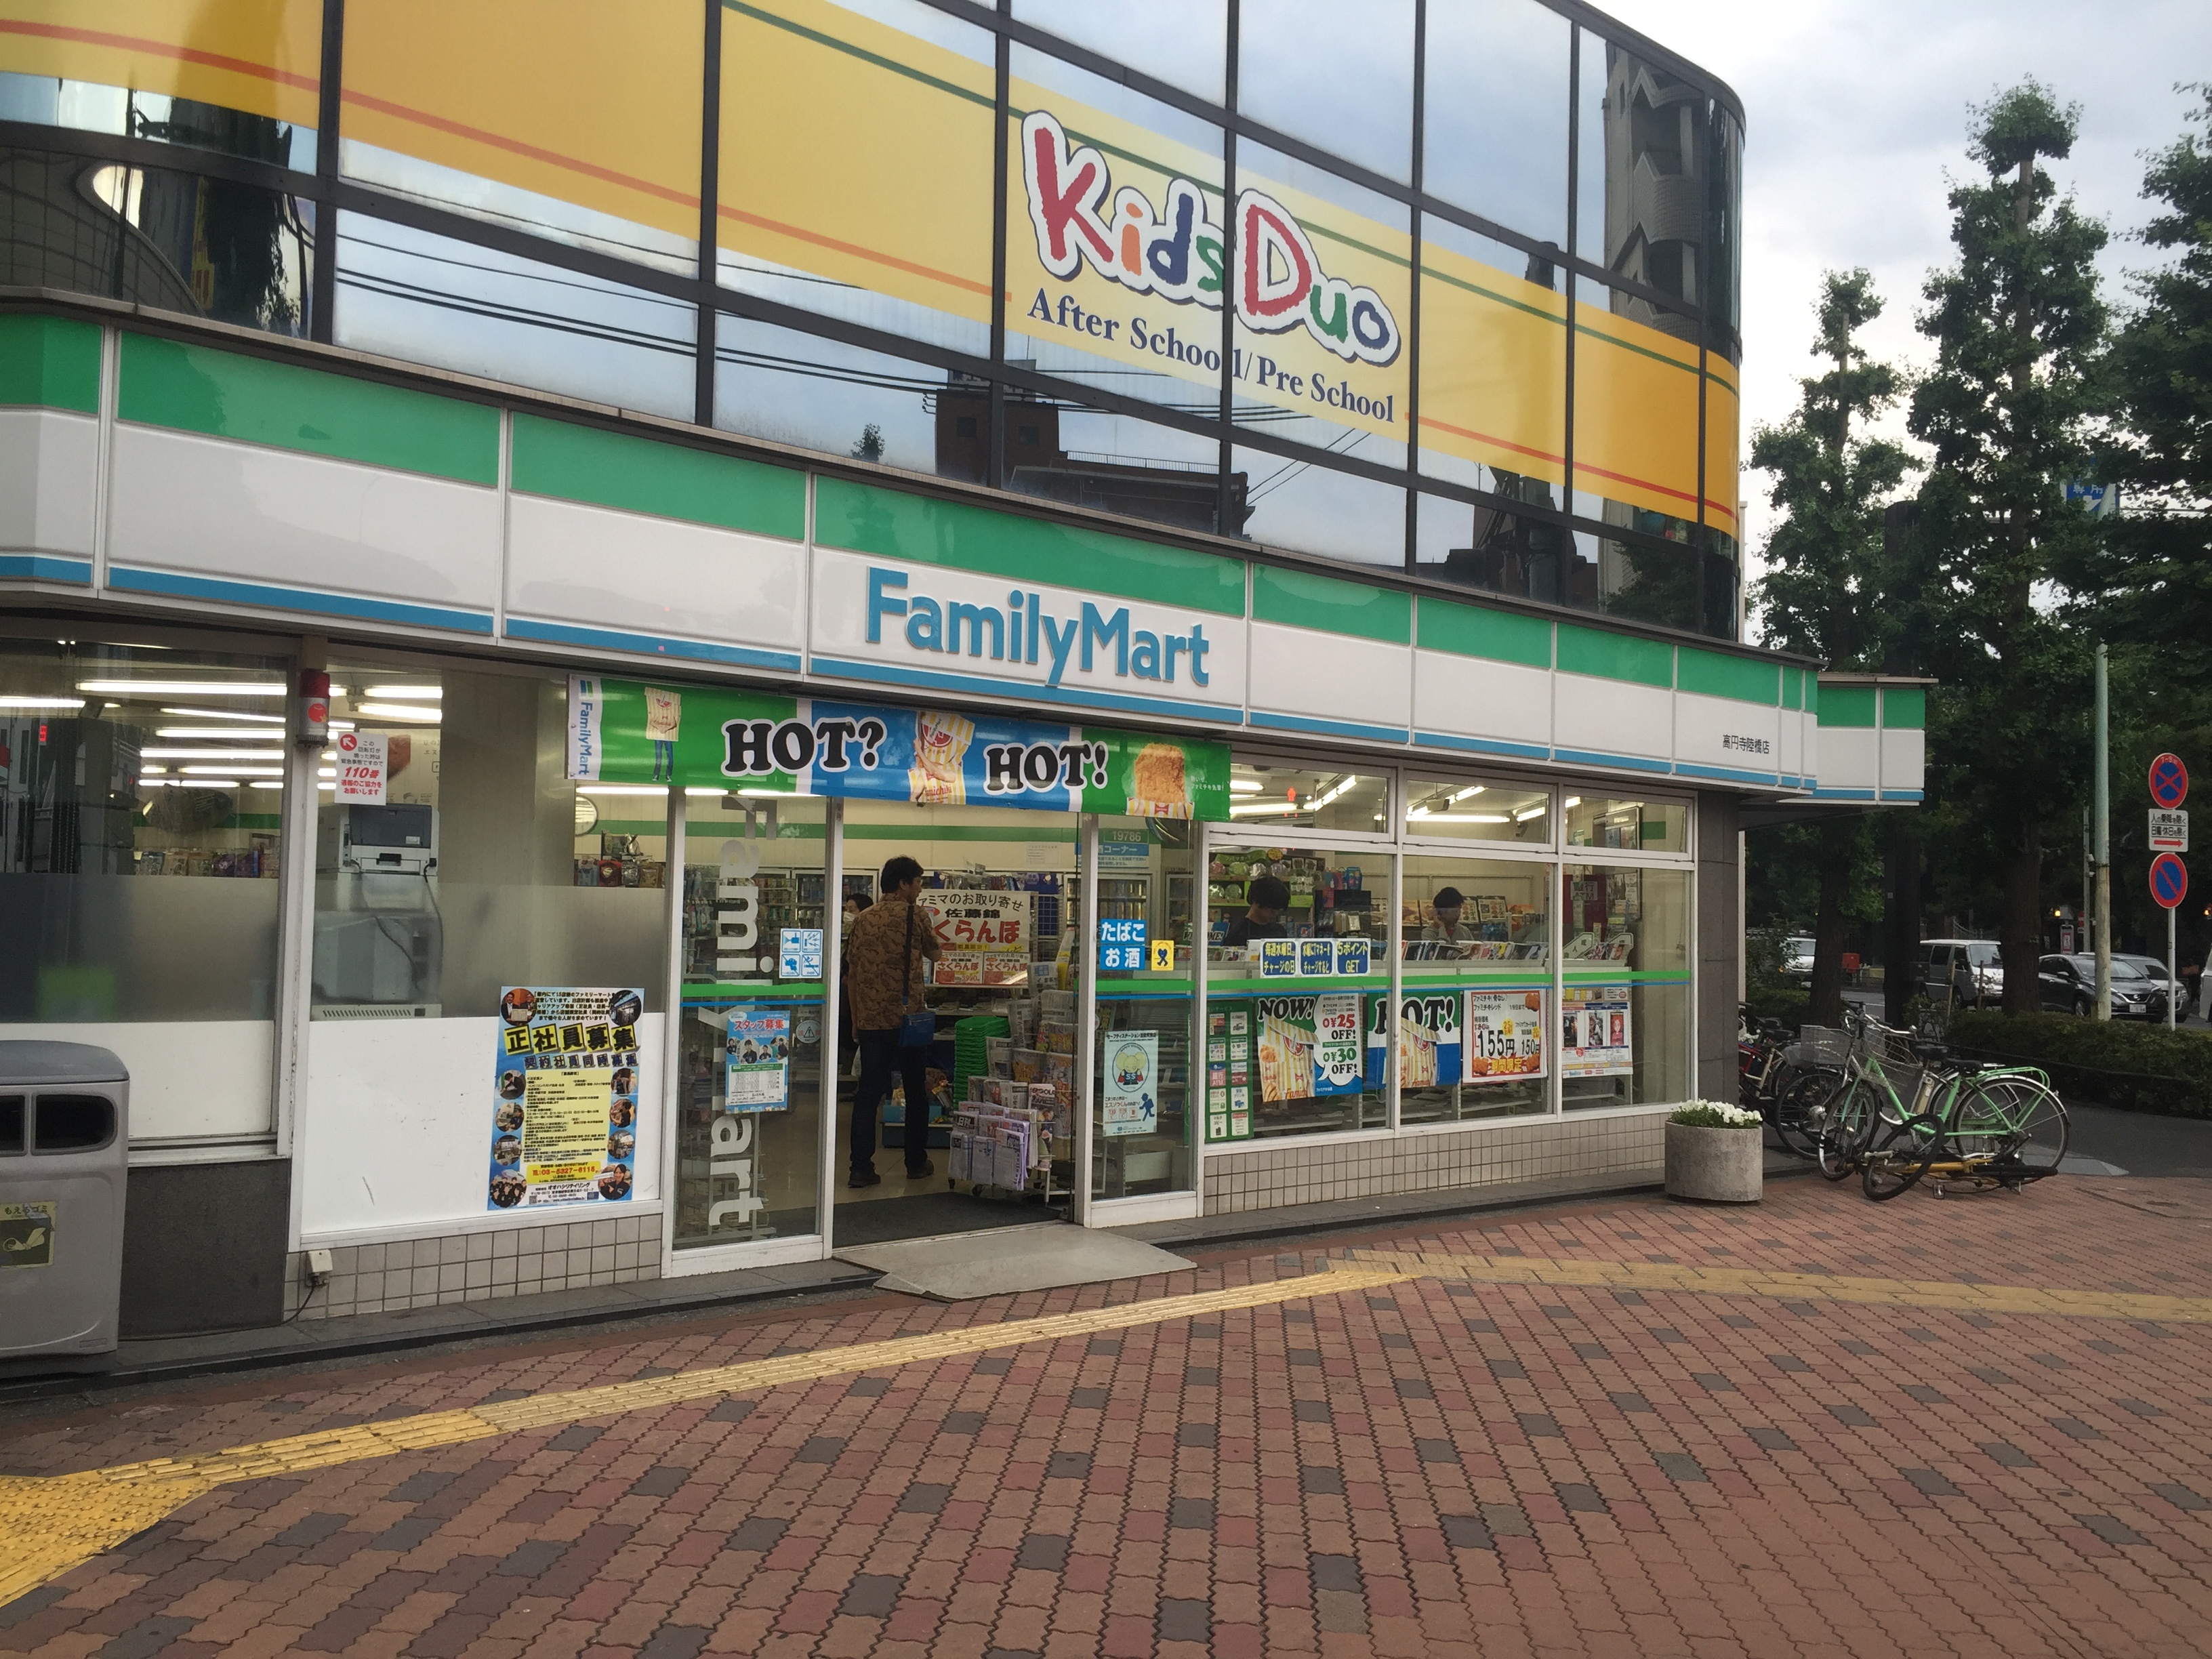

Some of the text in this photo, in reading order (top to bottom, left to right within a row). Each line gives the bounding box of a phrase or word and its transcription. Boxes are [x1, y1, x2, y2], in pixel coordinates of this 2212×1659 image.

[1027, 287, 1120, 342] After
[1310, 373, 1395, 424] School
[865, 565, 1210, 688] FamilyMart
[577, 701, 593, 776] FamilyMart
[724, 719, 885, 774] HOT?
[1722, 734, 1770, 754] 高円寺陸橋店
[344, 766, 380, 779] 110番
[985, 741, 1108, 793] HOT!
[1112, 831, 1142, 842] 19786
[918, 893, 1025, 912] ァミマのお取り寄せ
[933, 919, 1021, 943] くらんぼ
[1101, 921, 1145, 942] たばこ
[1105, 947, 1141, 968] お酒
[1337, 942, 1368, 956] 5ポイント
[937, 962, 979, 970] さくらんぼ
[1264, 960, 1295, 974] チャージの日
[1345, 960, 1359, 973] GET
[1258, 998, 1315, 1021] NOW!
[734, 1018, 784, 1030] スタッフ募集
[506, 1025, 635, 1052] 正社員募集
[1331, 1029, 1356, 1040] OFF!
[1477, 1029, 1515, 1057] 155円
[524, 1054, 638, 1069] 契約社員同時募集
[1331, 1063, 1357, 1075] OFF!
[1492, 1058, 1523, 1073] 期間限定
